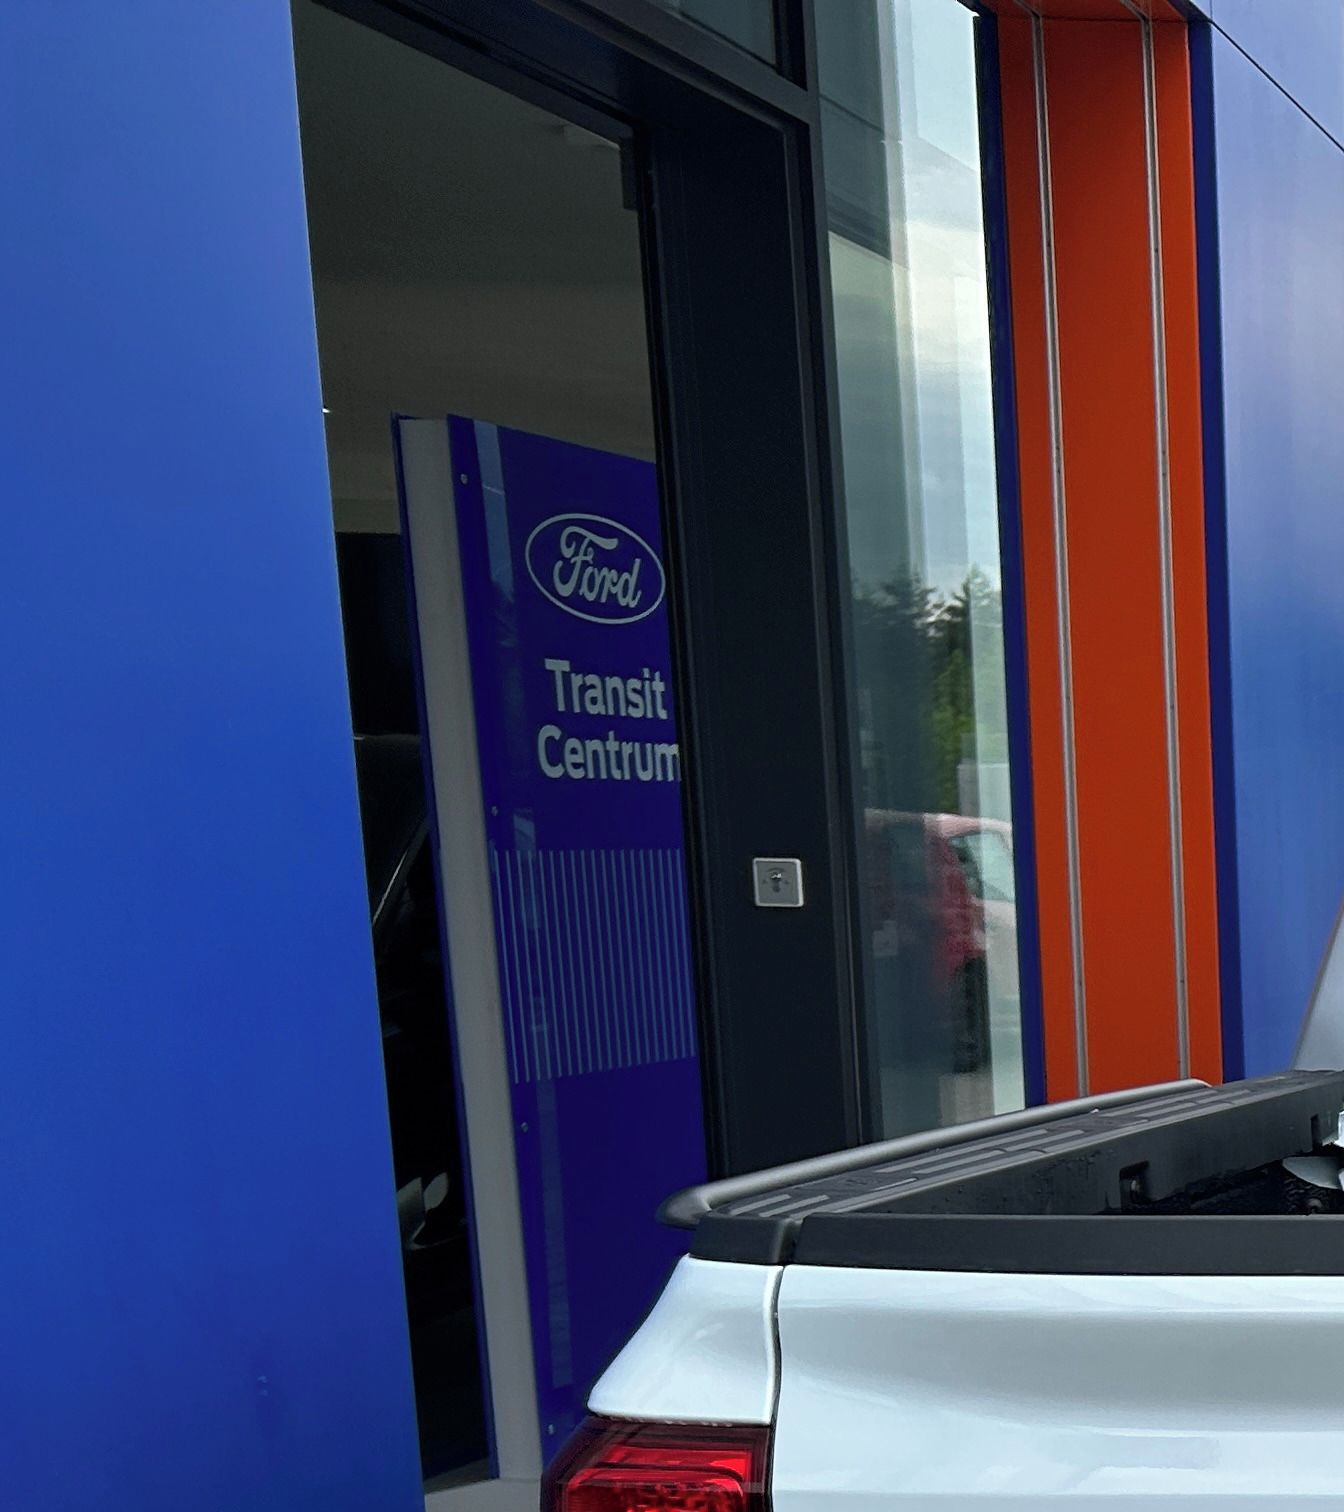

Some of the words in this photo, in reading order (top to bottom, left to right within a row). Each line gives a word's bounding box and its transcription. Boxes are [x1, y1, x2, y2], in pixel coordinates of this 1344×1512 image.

[553, 526, 641, 608] Ford
[544, 658, 668, 720] Transit
[537, 724, 682, 783] Centrum
